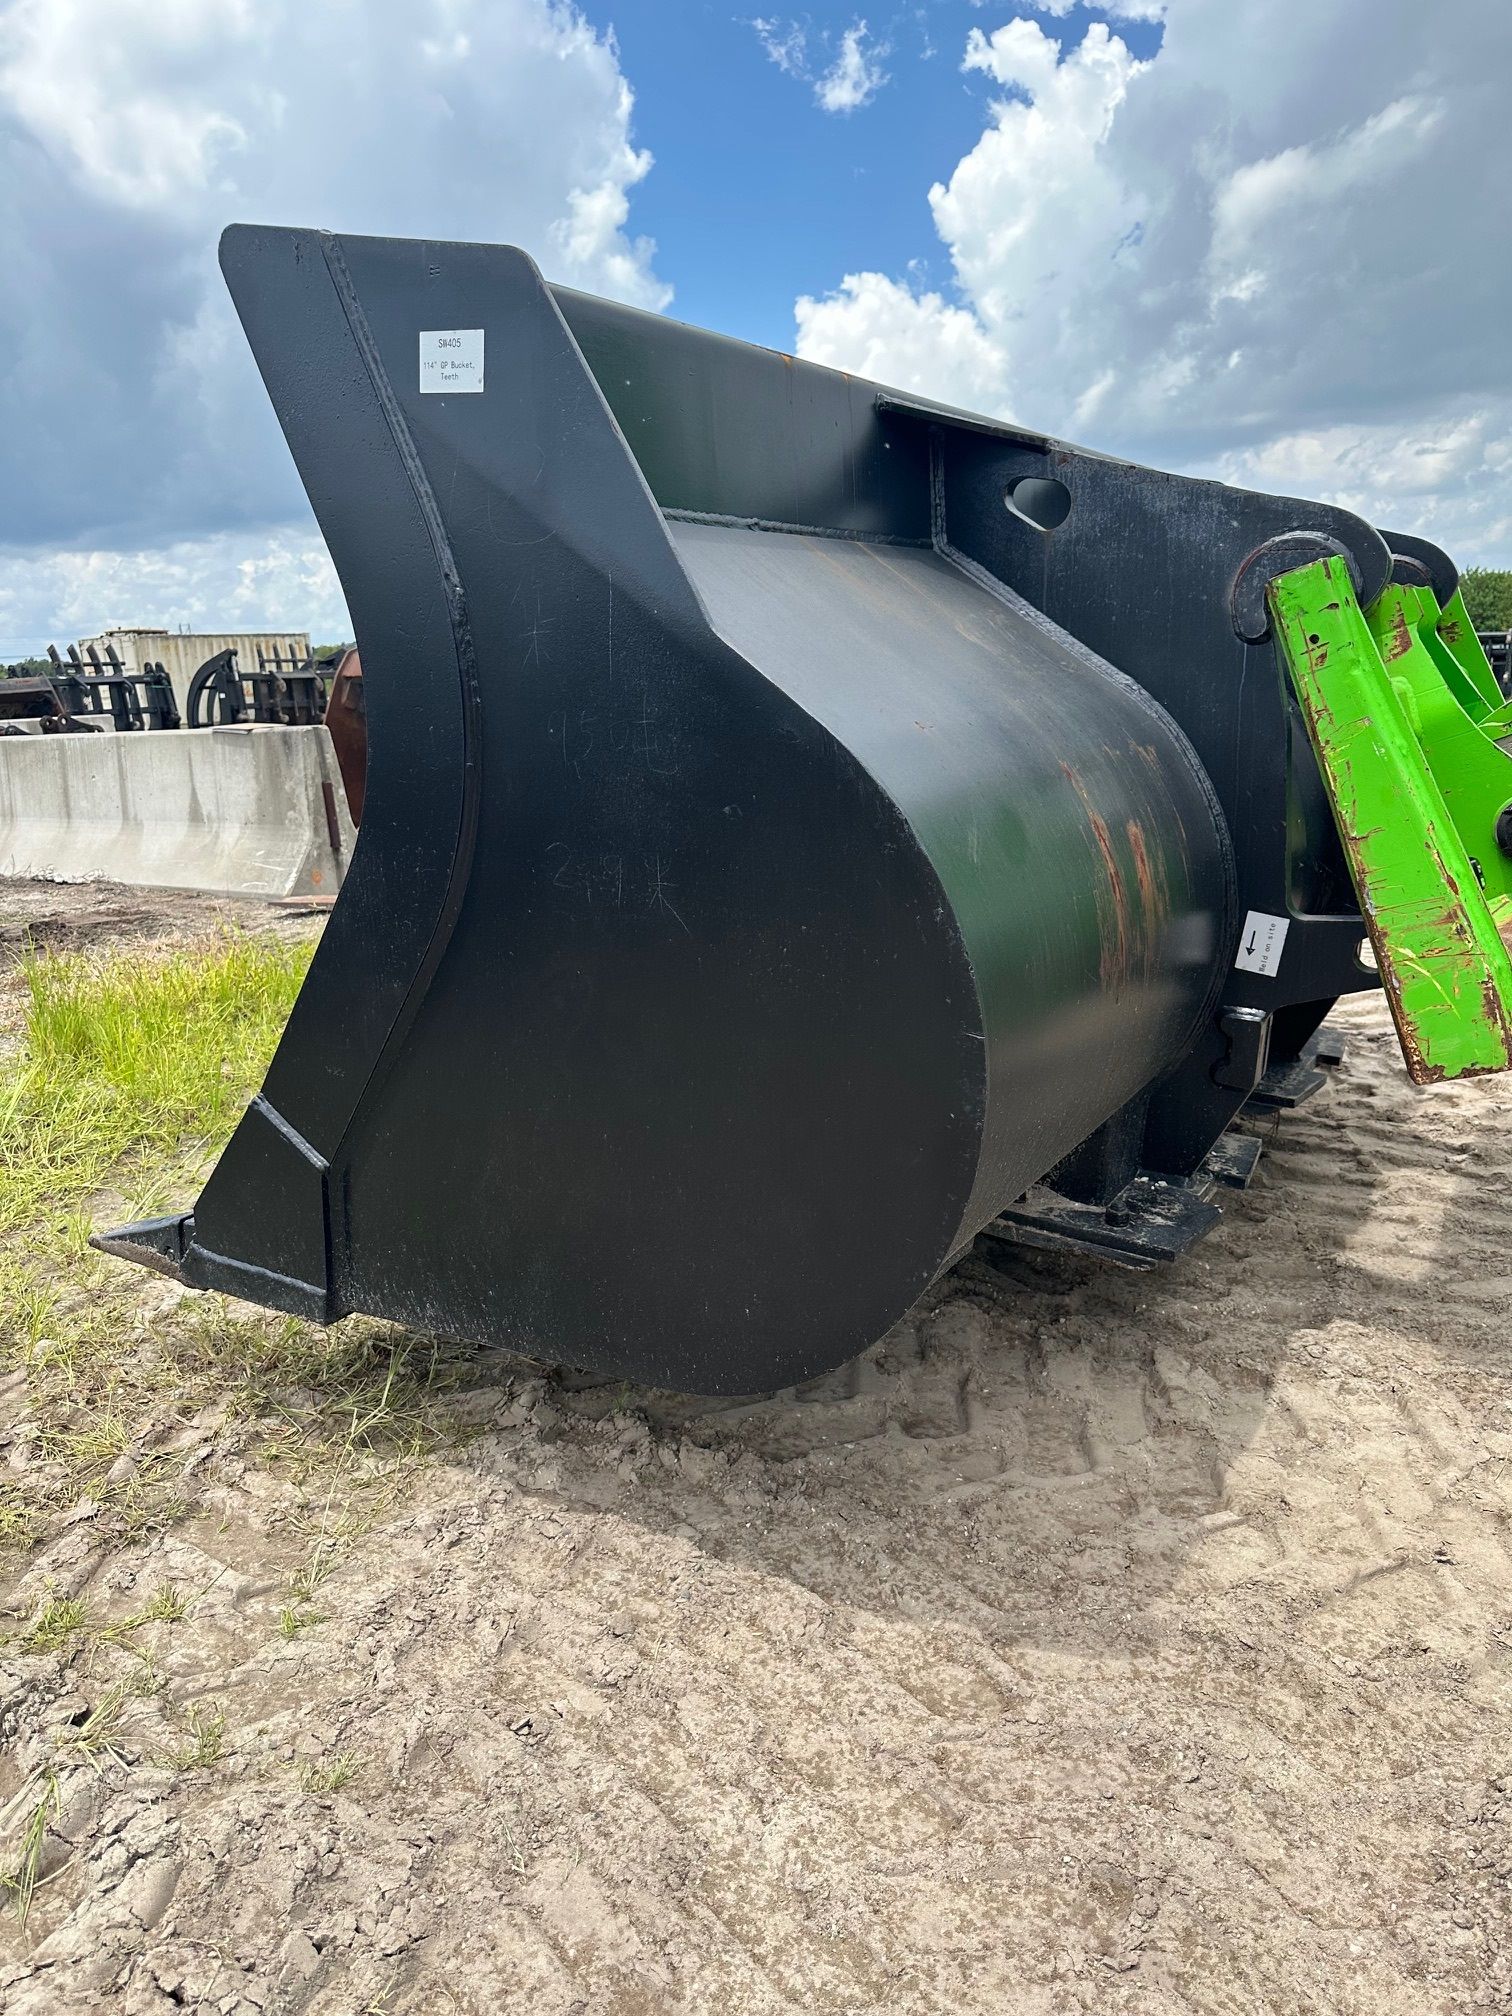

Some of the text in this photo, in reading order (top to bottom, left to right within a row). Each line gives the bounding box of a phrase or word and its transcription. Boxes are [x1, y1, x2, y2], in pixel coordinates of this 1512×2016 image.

[438, 338, 461, 348] SW405
[440, 361, 448, 369] GP
[451, 361, 475, 369] Bucket,
[441, 372, 459, 380] Teeth
[1265, 943, 1271, 952] on
[1268, 923, 1277, 940] site
